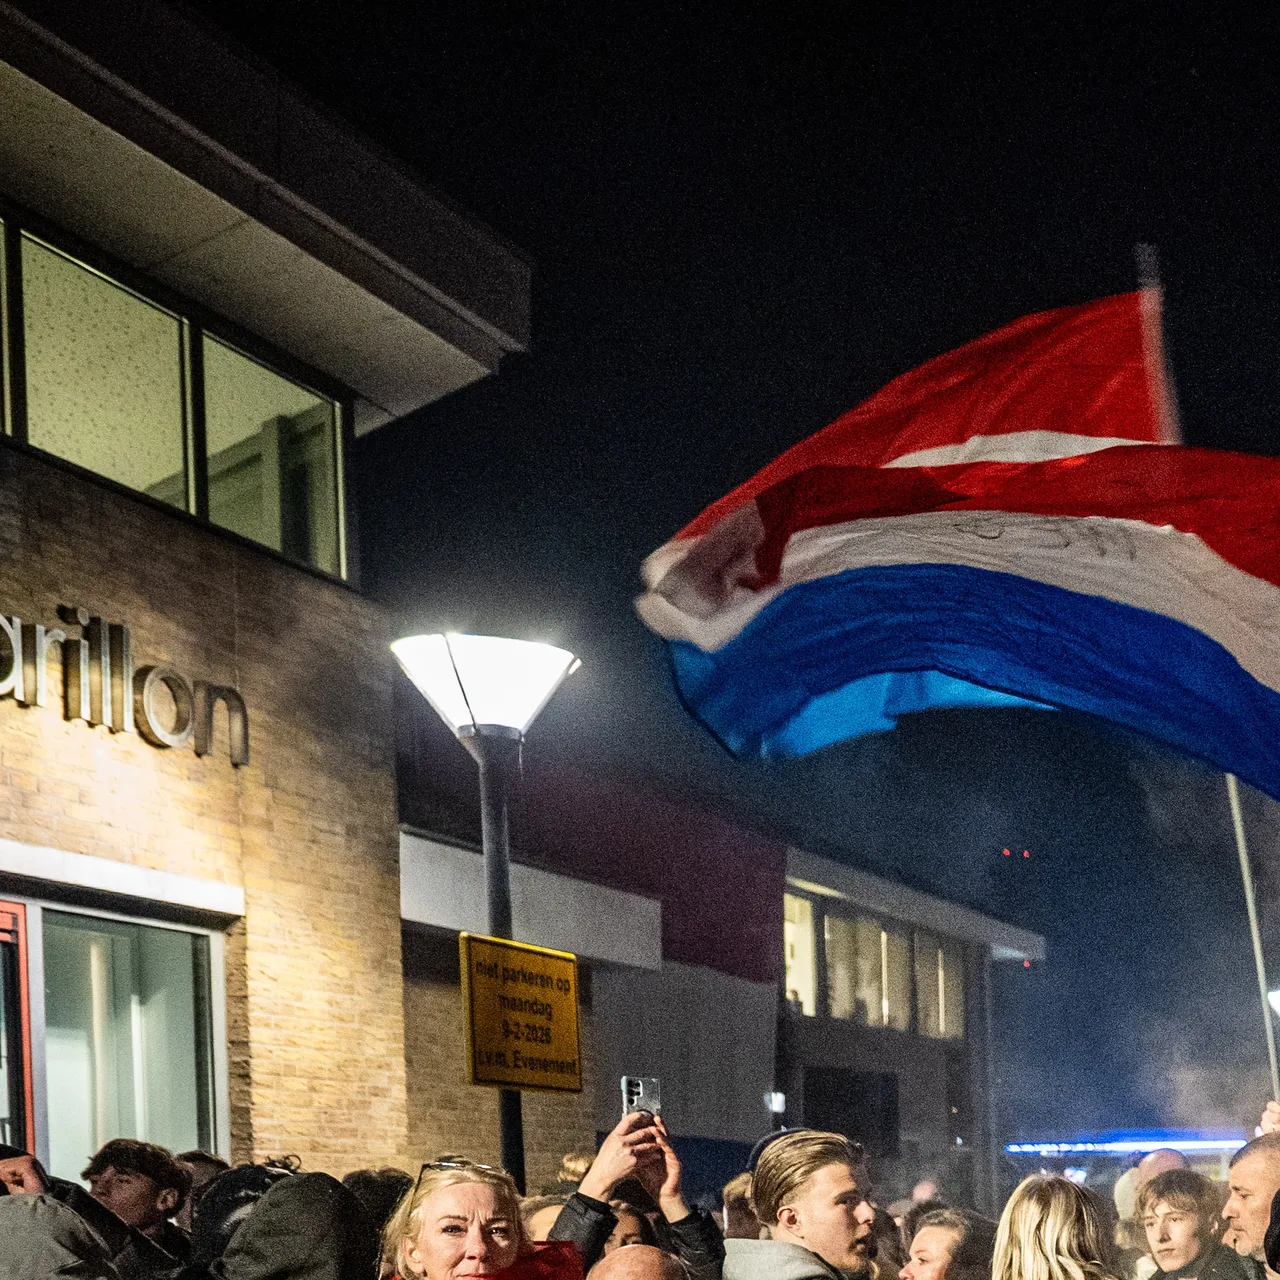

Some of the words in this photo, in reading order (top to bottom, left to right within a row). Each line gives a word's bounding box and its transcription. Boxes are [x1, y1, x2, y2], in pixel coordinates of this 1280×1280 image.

[501, 965, 553, 990] parkeren
[556, 977, 571, 996] op
[500, 994, 552, 1021] maandag
